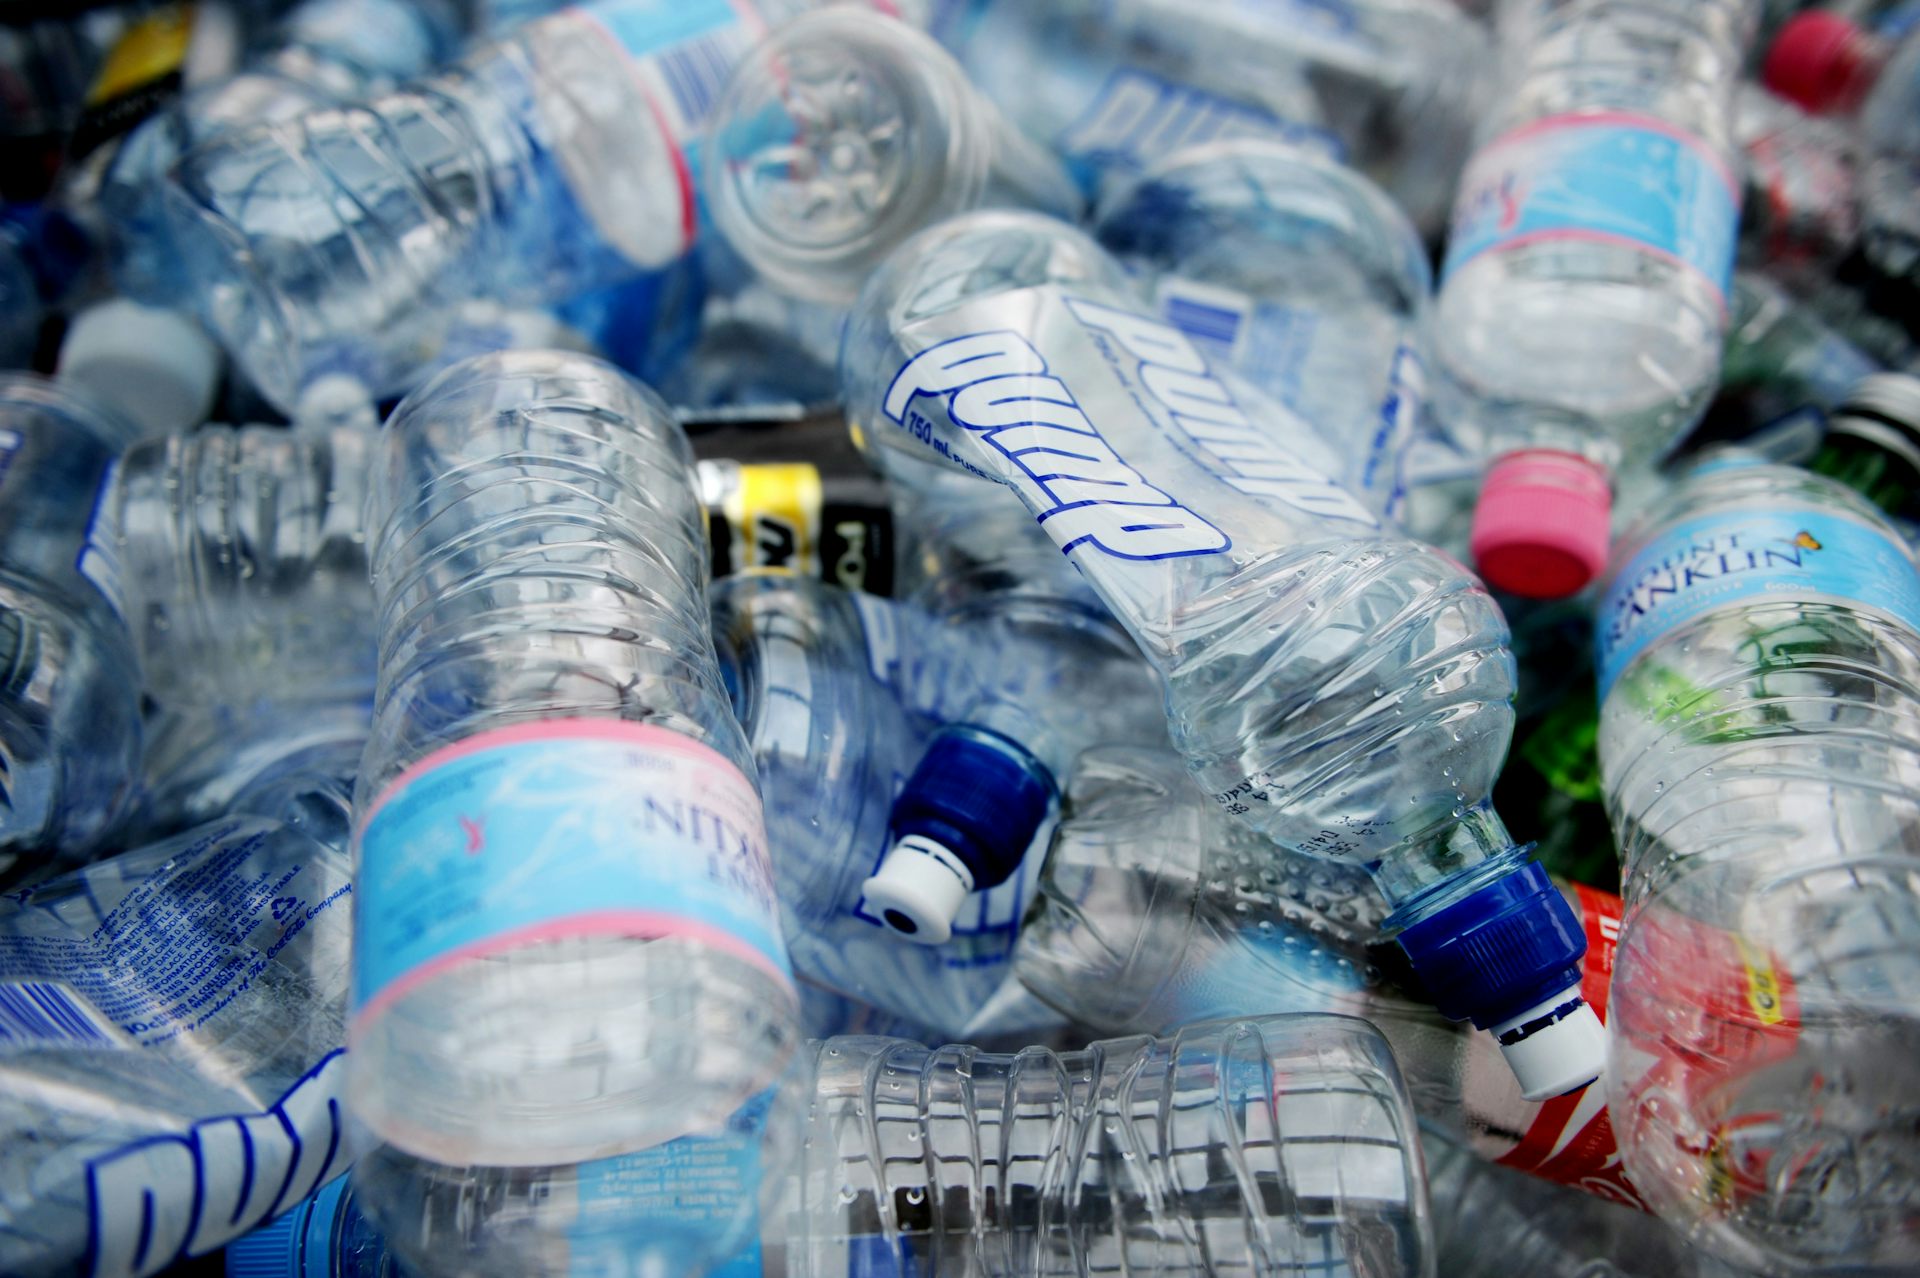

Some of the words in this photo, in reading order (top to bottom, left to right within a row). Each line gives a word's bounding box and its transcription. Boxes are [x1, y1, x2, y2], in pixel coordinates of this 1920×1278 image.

[883, 329, 1232, 561] pump
[909, 411, 932, 444] 750
[933, 438, 952, 459] mL
[92, 908, 118, 938] pump
[119, 886, 140, 907] pure
[123, 906, 163, 944] AUTHORITY
[162, 896, 173, 906] OF
[172, 882, 188, 897] THE
[134, 885, 153, 904] Get
[159, 908, 188, 936] SODIUM
[140, 934, 175, 966] CALCIUM
[187, 884, 228, 922] POTASSIUM
[147, 947, 202, 992] INFORMATION
[201, 927, 224, 948] CALL
[228, 909, 242, 923] 800
[241, 896, 256, 910] 025
[255, 883, 269, 896] 123
[156, 947, 175, 966] DATE
[174, 932, 190, 948] SEE
[189, 913, 210, 934] NECK
[209, 904, 220, 915] OF
[159, 978, 182, 996] THIS
[182, 943, 219, 979] SPORTS
[219, 925, 239, 944] CAP
[238, 915, 249, 926] IS
[248, 864, 301, 917] UNSUITABLE
[185, 917, 219, 950] PRODUCT
[219, 906, 231, 918] OF
[195, 989, 237, 1026] product
[237, 976, 249, 991] of
[246, 957, 267, 978] The
[302, 881, 353, 920] Company
[187, 994, 197, 1004] AT
[198, 955, 240, 995] COLLECTION
[189, 954, 222, 986] UNDER
[222, 947, 230, 955] 3
